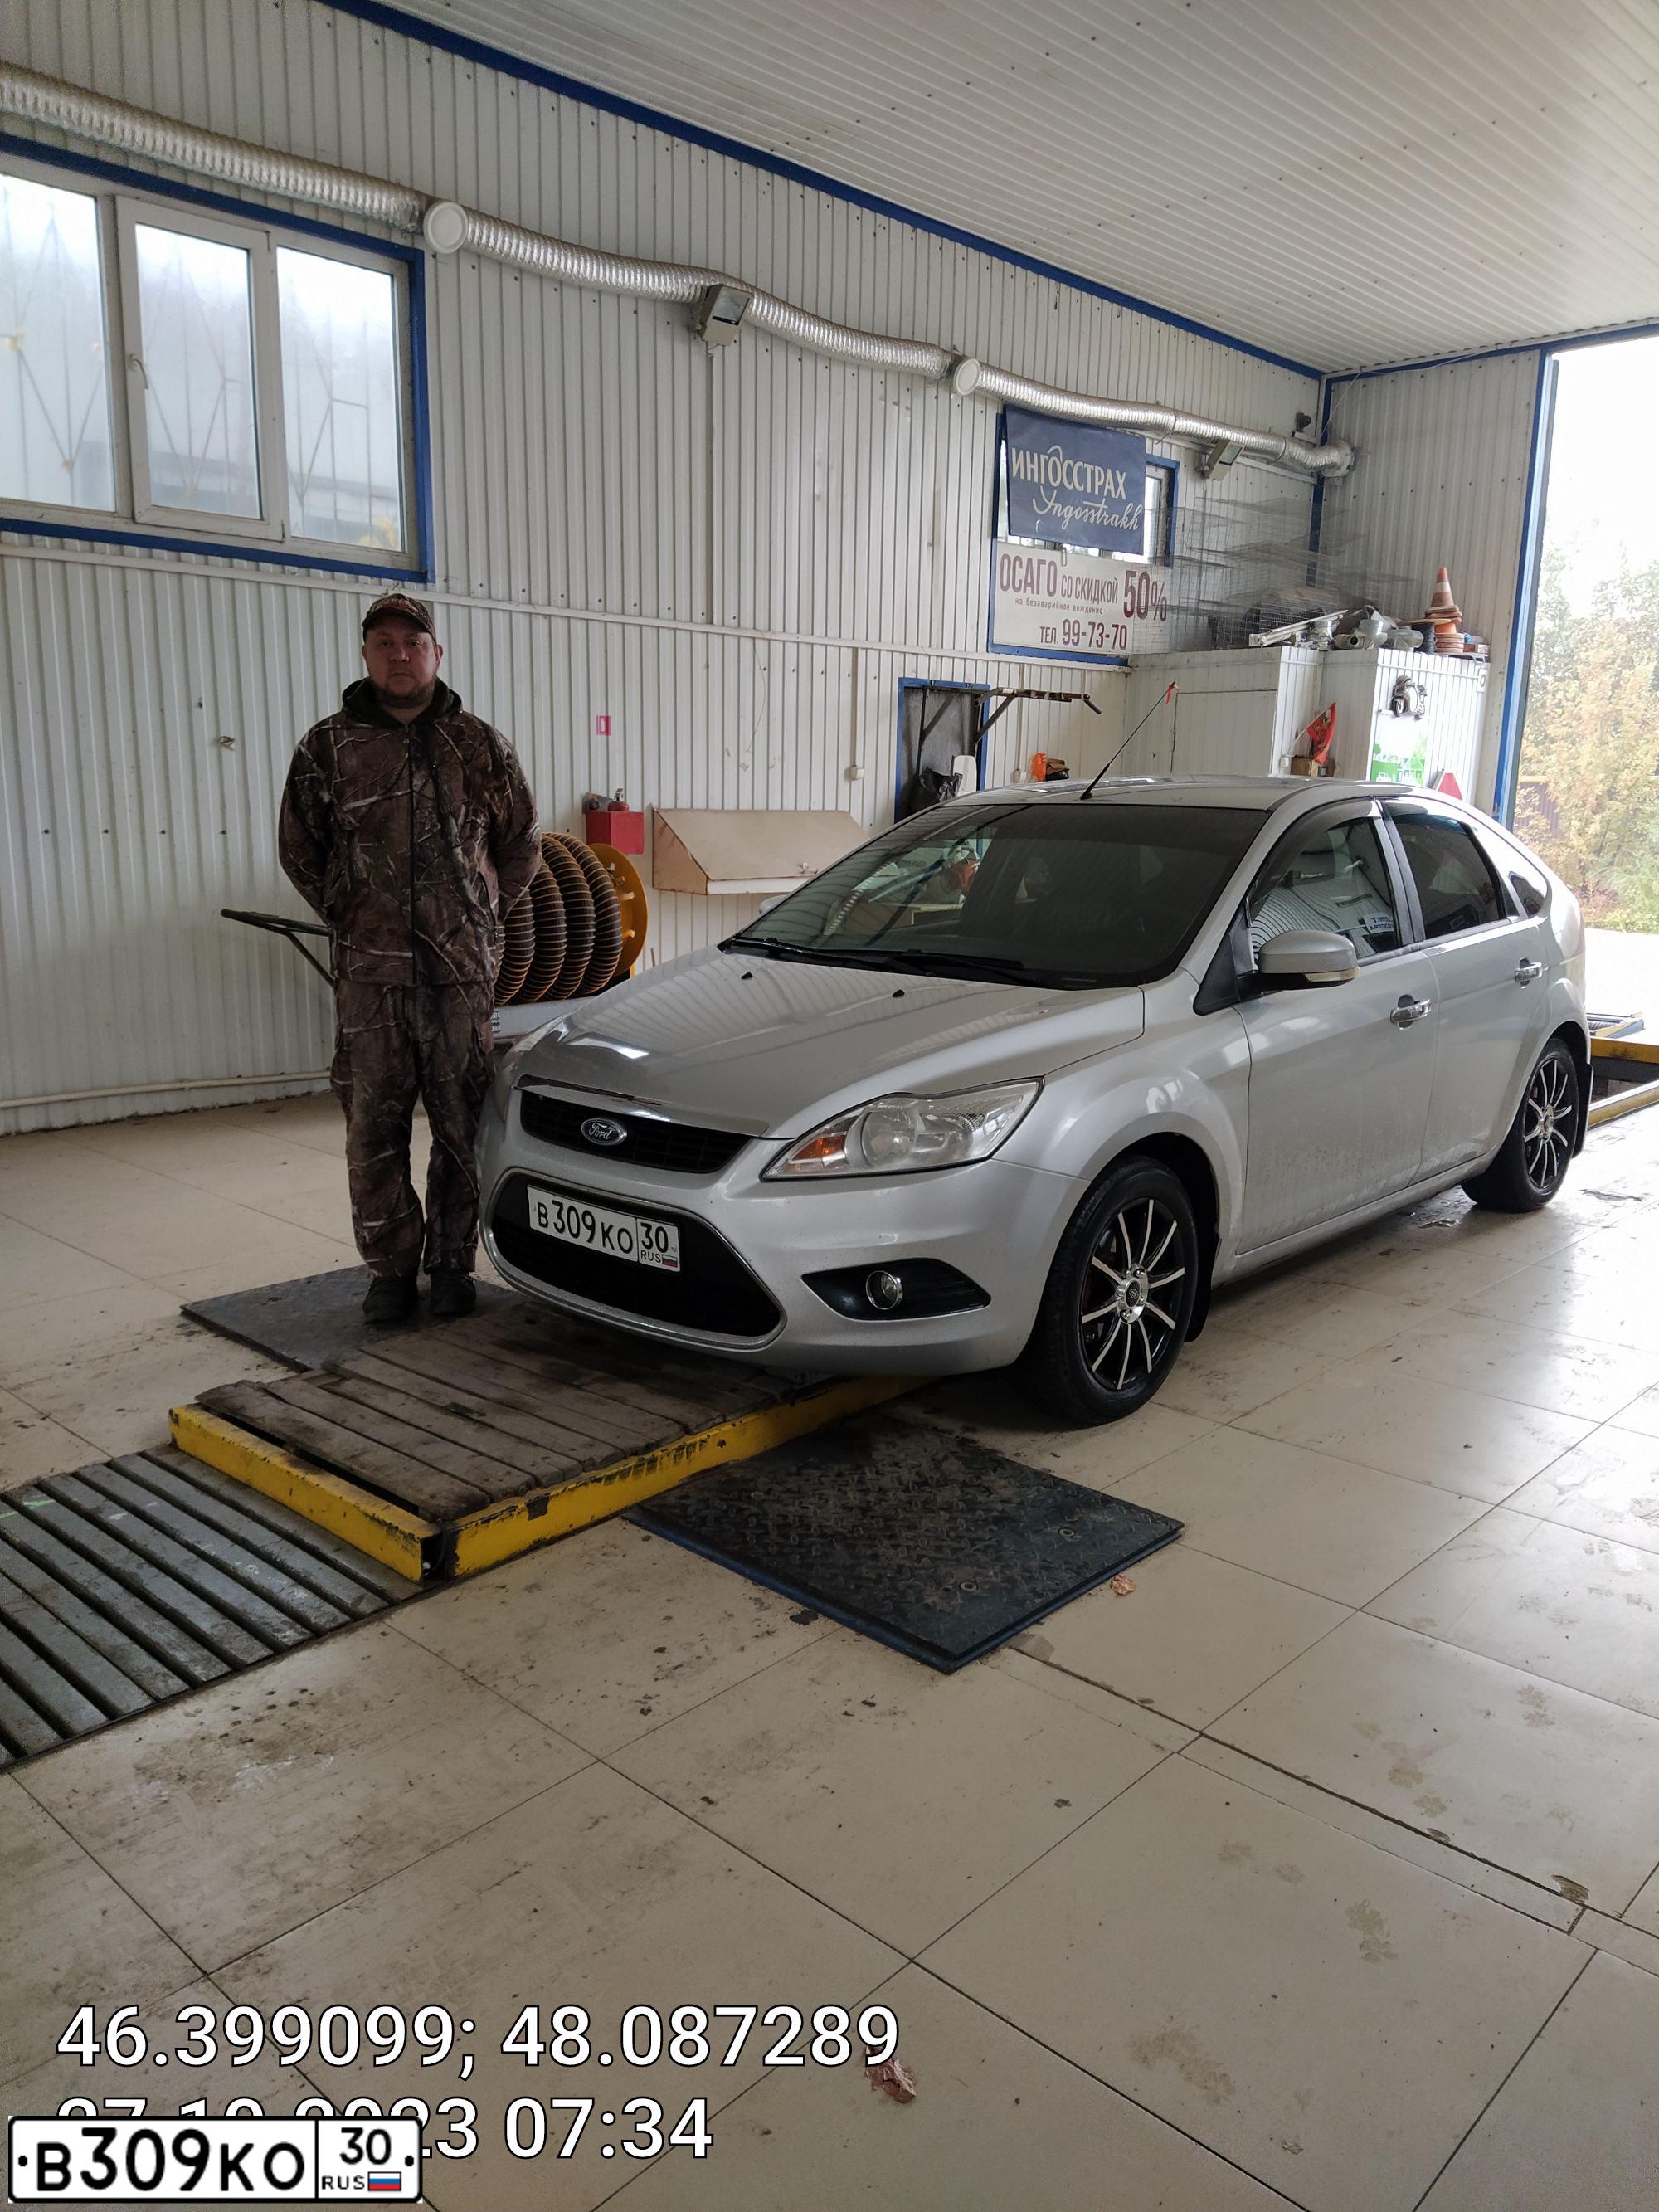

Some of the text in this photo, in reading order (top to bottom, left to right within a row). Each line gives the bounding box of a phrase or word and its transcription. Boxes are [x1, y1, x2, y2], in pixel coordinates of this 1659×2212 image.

[1010, 445, 1126, 500] ИНГОССТРАХ
[1032, 485, 1143, 530] Ingosstrakh
[1000, 553, 1058, 597] ОСАГО
[1074, 575, 1119, 604] СКИДКОЙ
[1123, 570, 1167, 622] 50%
[1014, 597, 1103, 615] на безаварийное вождение
[1039, 618, 1127, 651] ТЕЛ. 99-73-70
[588, 1123, 612, 1140] Ford
[640, 1222, 669, 1253] 30
[640, 1250, 662, 1264] RUS
